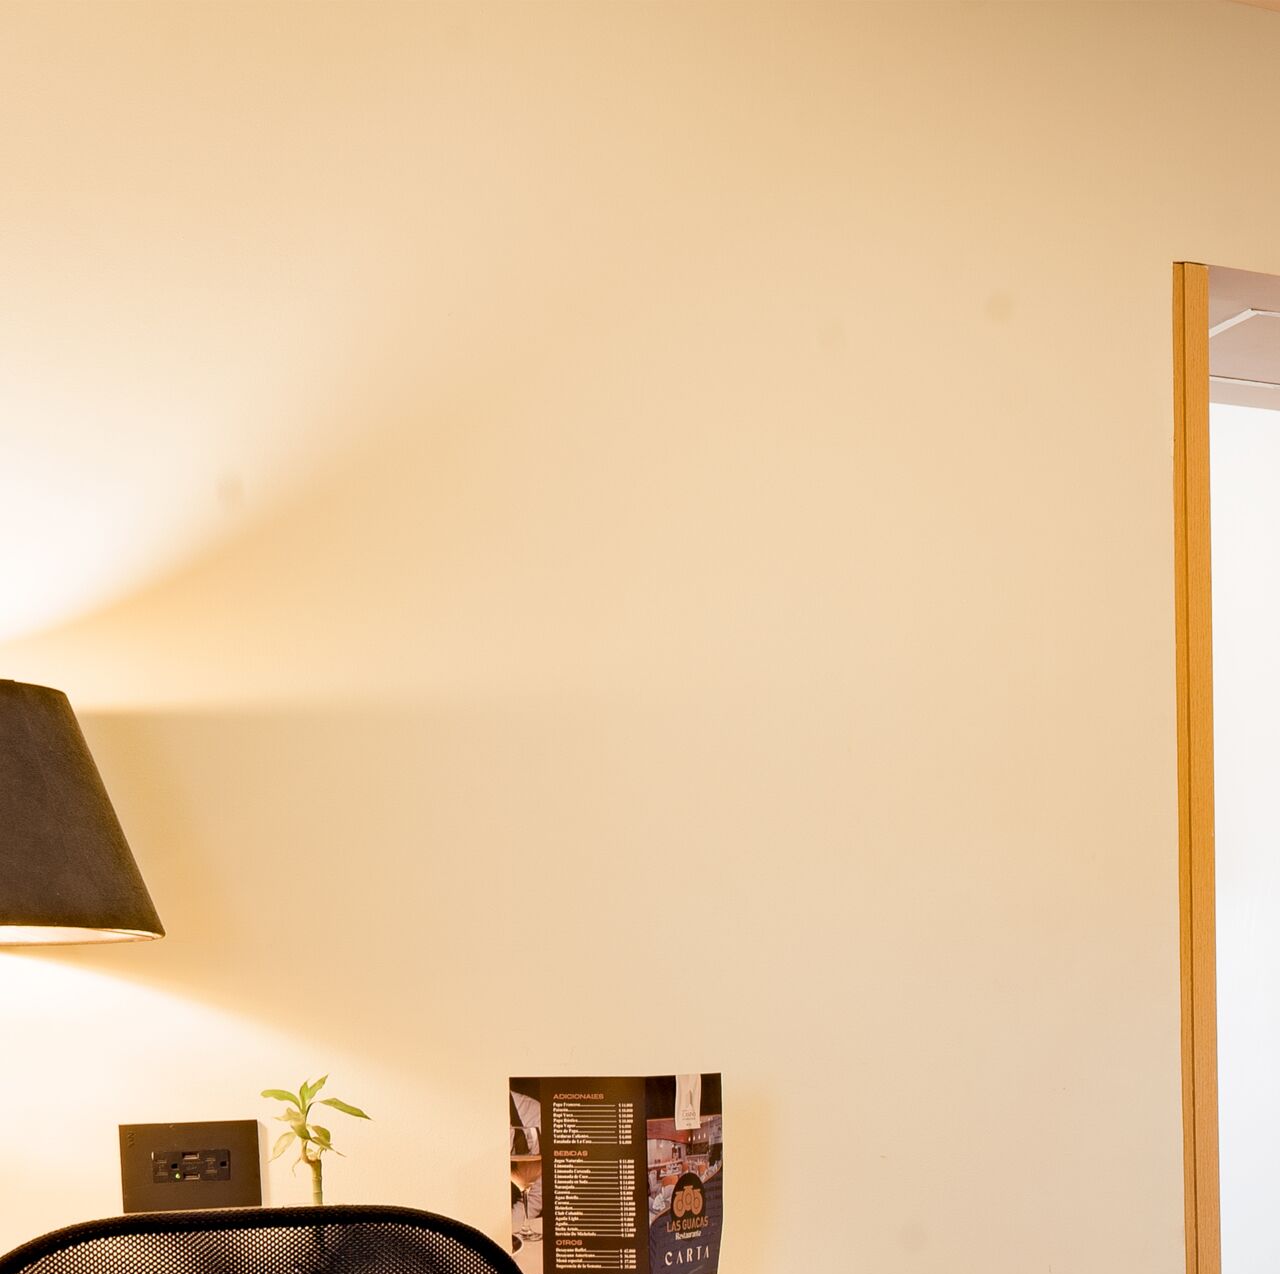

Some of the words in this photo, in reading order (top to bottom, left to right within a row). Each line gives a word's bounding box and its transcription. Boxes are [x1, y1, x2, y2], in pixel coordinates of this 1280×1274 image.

[666, 1220, 681, 1232] LAS
[682, 1216, 708, 1230] GUACAS
[675, 1231, 701, 1240] Restaurante
[665, 1246, 709, 1266] CARTA
